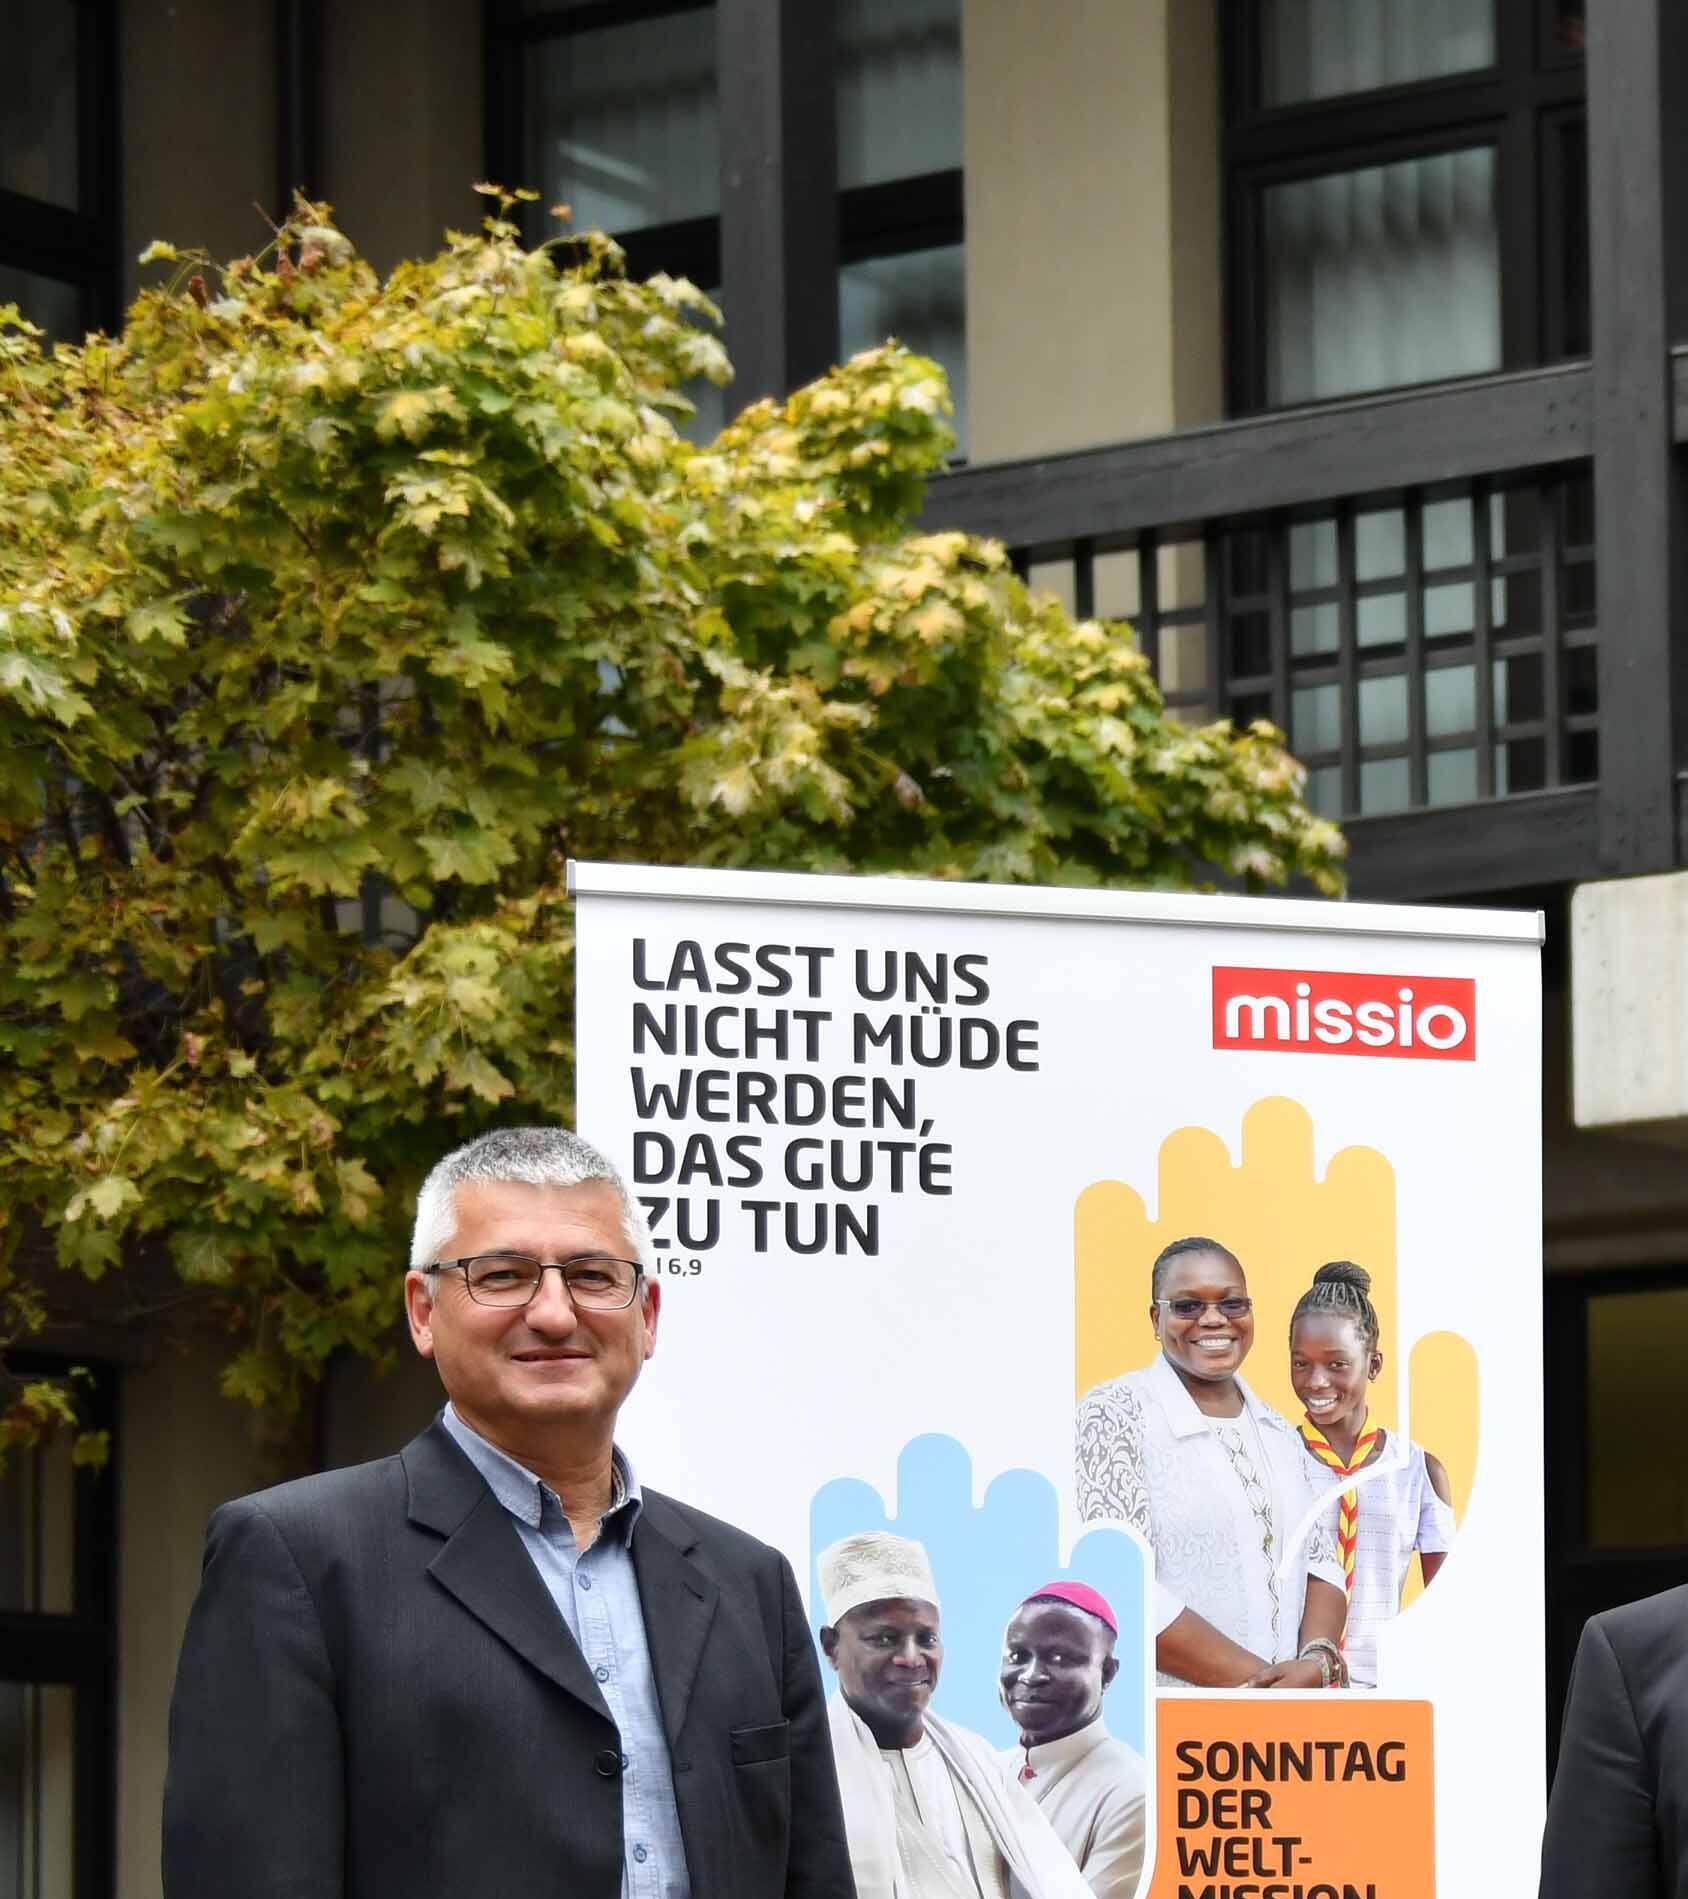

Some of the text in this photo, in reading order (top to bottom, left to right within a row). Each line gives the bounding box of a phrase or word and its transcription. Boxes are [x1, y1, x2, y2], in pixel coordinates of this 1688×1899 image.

[632, 937, 991, 1006] LASST UNS
[632, 1002, 1040, 1071] NICHT MÜDE
[1225, 982, 1467, 1050] missio
[630, 1066, 935, 1137] WERDEN,
[632, 1131, 953, 1196] DAS GUTE
[741, 1199, 880, 1257] TUN
[668, 1258, 702, 1277] 6,9
[1175, 1741, 1406, 1782] SONNTAG
[1176, 1788, 1273, 1830] DER
[1176, 1836, 1313, 1878] WELT-
